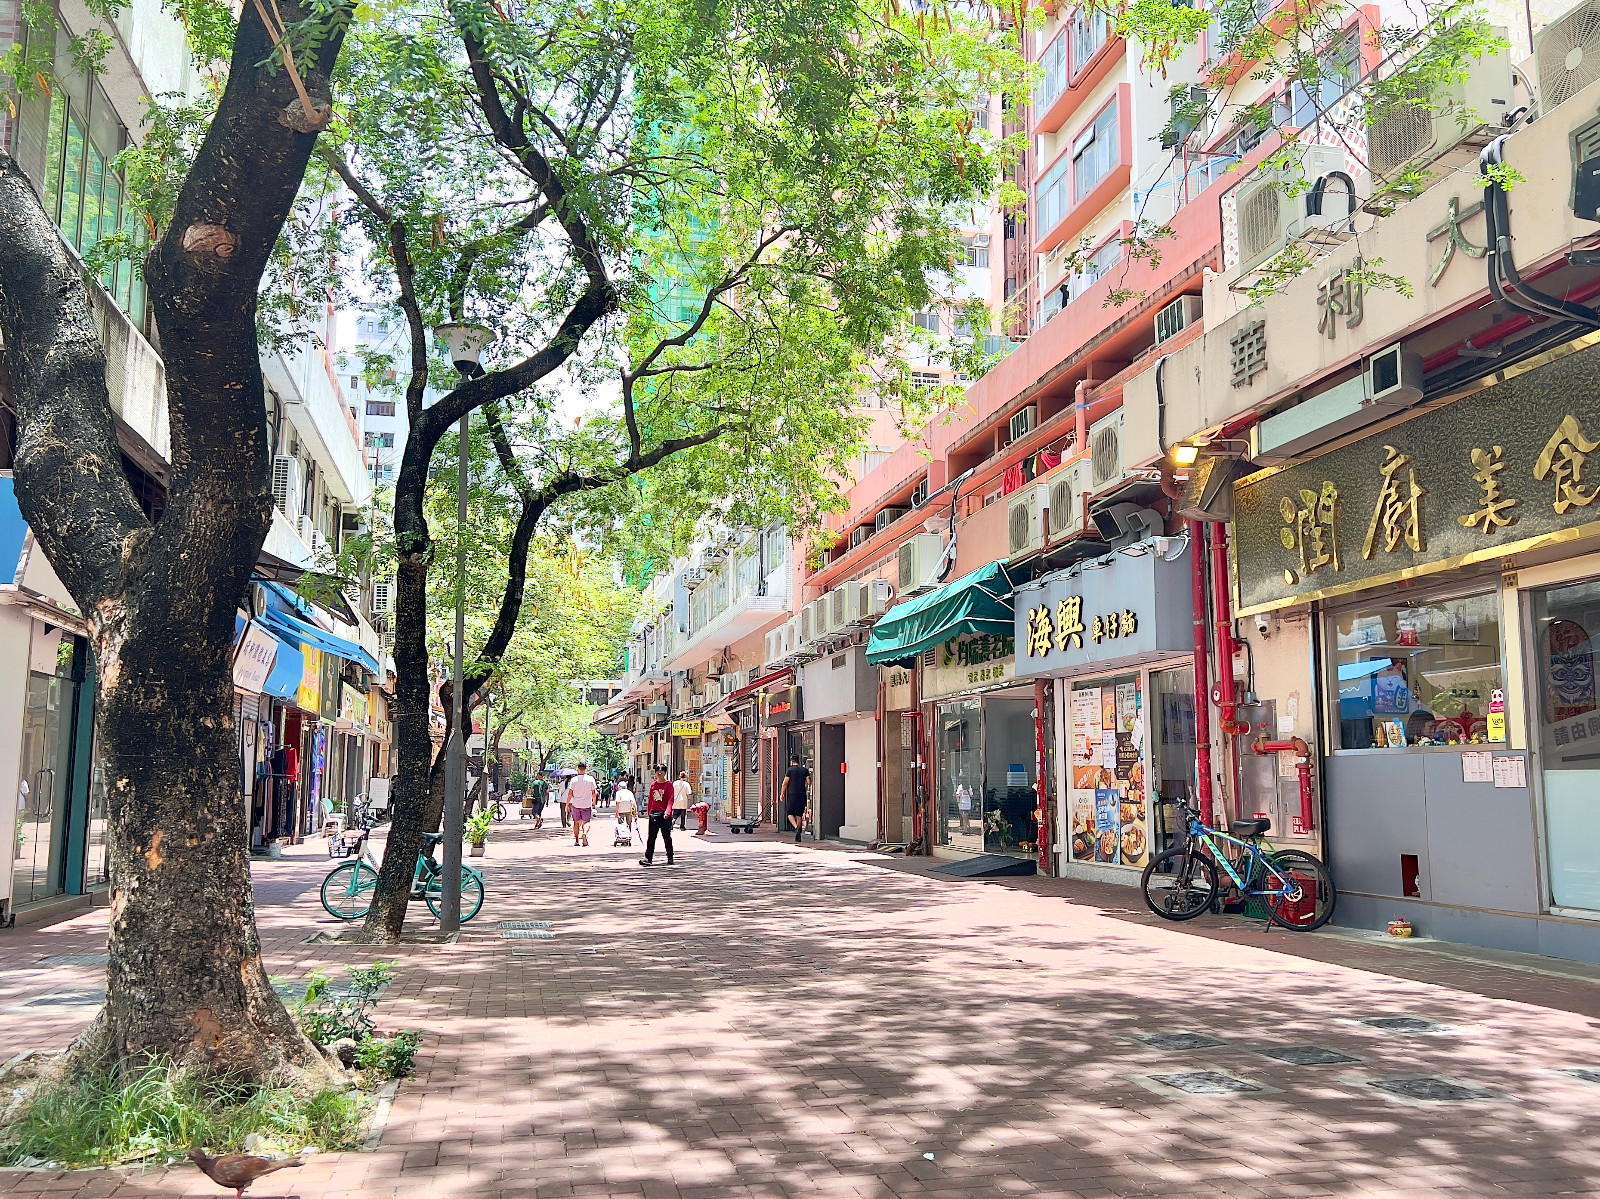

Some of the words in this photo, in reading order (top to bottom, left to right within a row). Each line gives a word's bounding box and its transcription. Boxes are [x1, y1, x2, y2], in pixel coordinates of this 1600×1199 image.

[1279, 414, 1600, 585] 潤廚美食
[1026, 595, 1086, 658] 海興
[1091, 608, 1138, 644] 車仔麵
